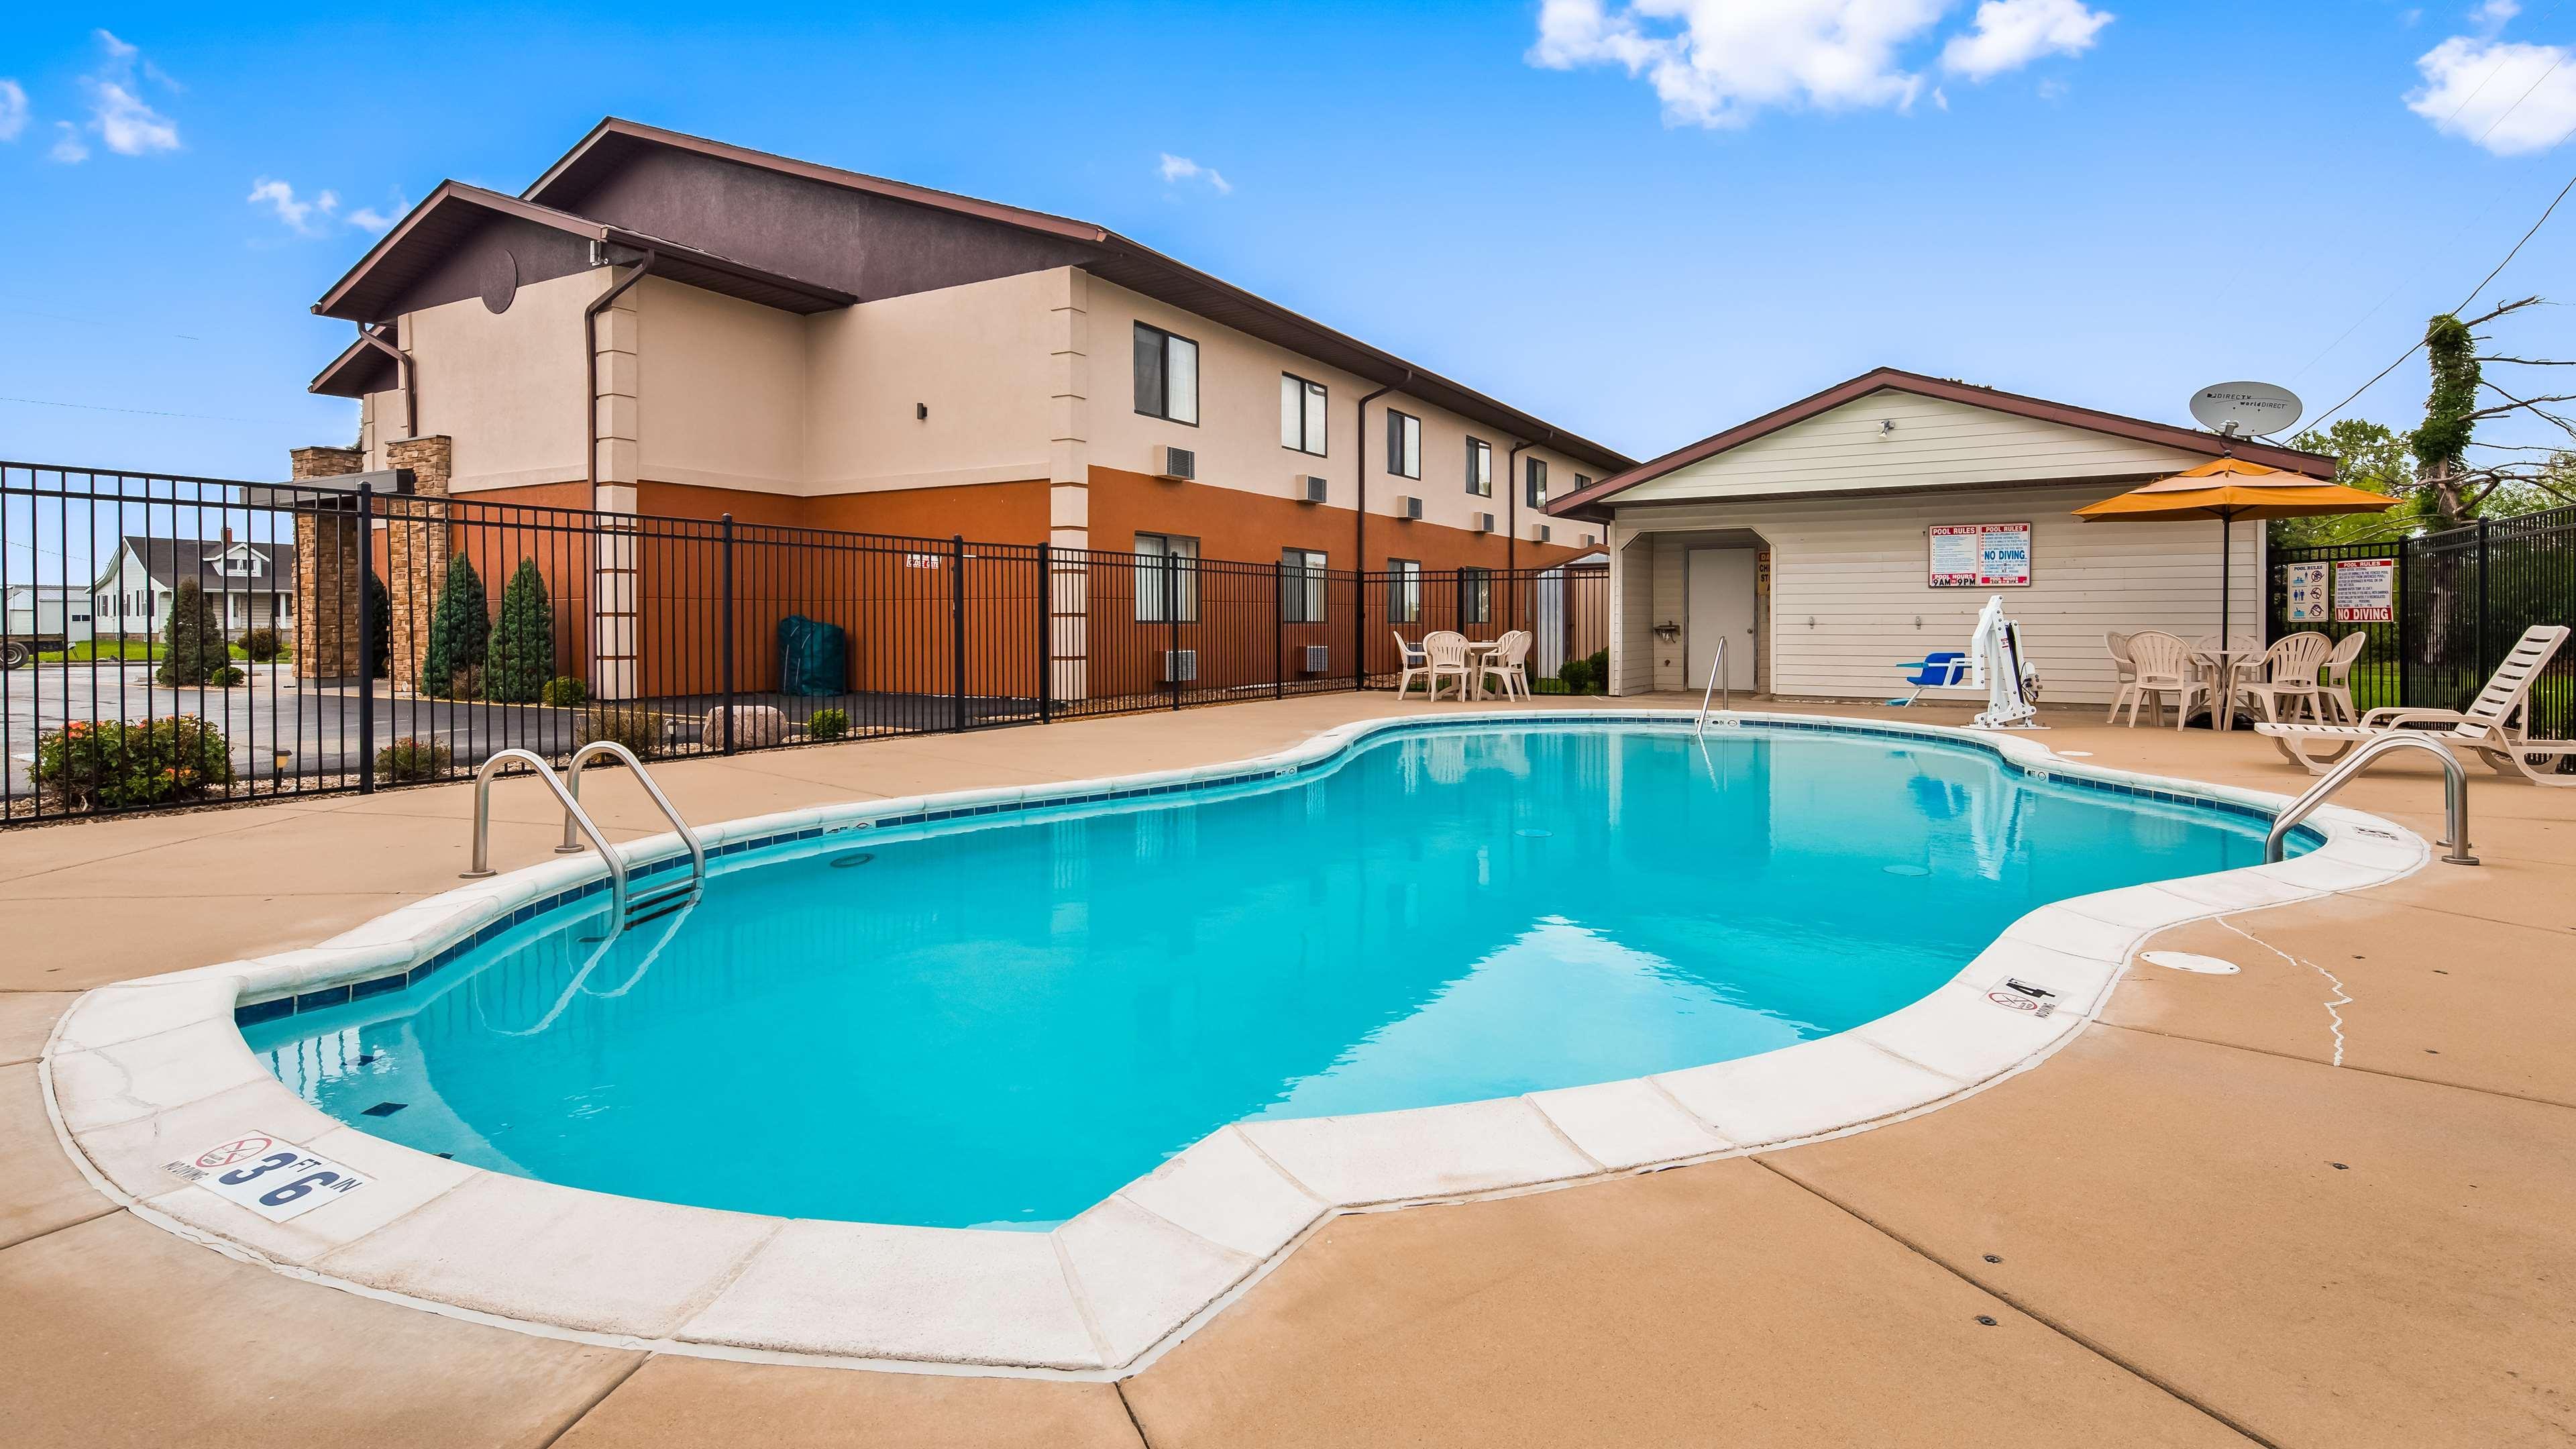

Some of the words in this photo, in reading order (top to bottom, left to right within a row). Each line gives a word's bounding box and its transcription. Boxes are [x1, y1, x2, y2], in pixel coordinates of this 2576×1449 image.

[1984, 550, 1995, 559] NO
[1999, 550, 2027, 559] DIVING.
[2338, 608, 2350, 620] NO
[2353, 608, 2388, 620] DIVING
[2006, 982, 2055, 998] 4
[219, 1152, 298, 1185] 3
[288, 1159, 322, 1173] FT
[259, 1171, 340, 1206] 6
[330, 1178, 363, 1193] IN
